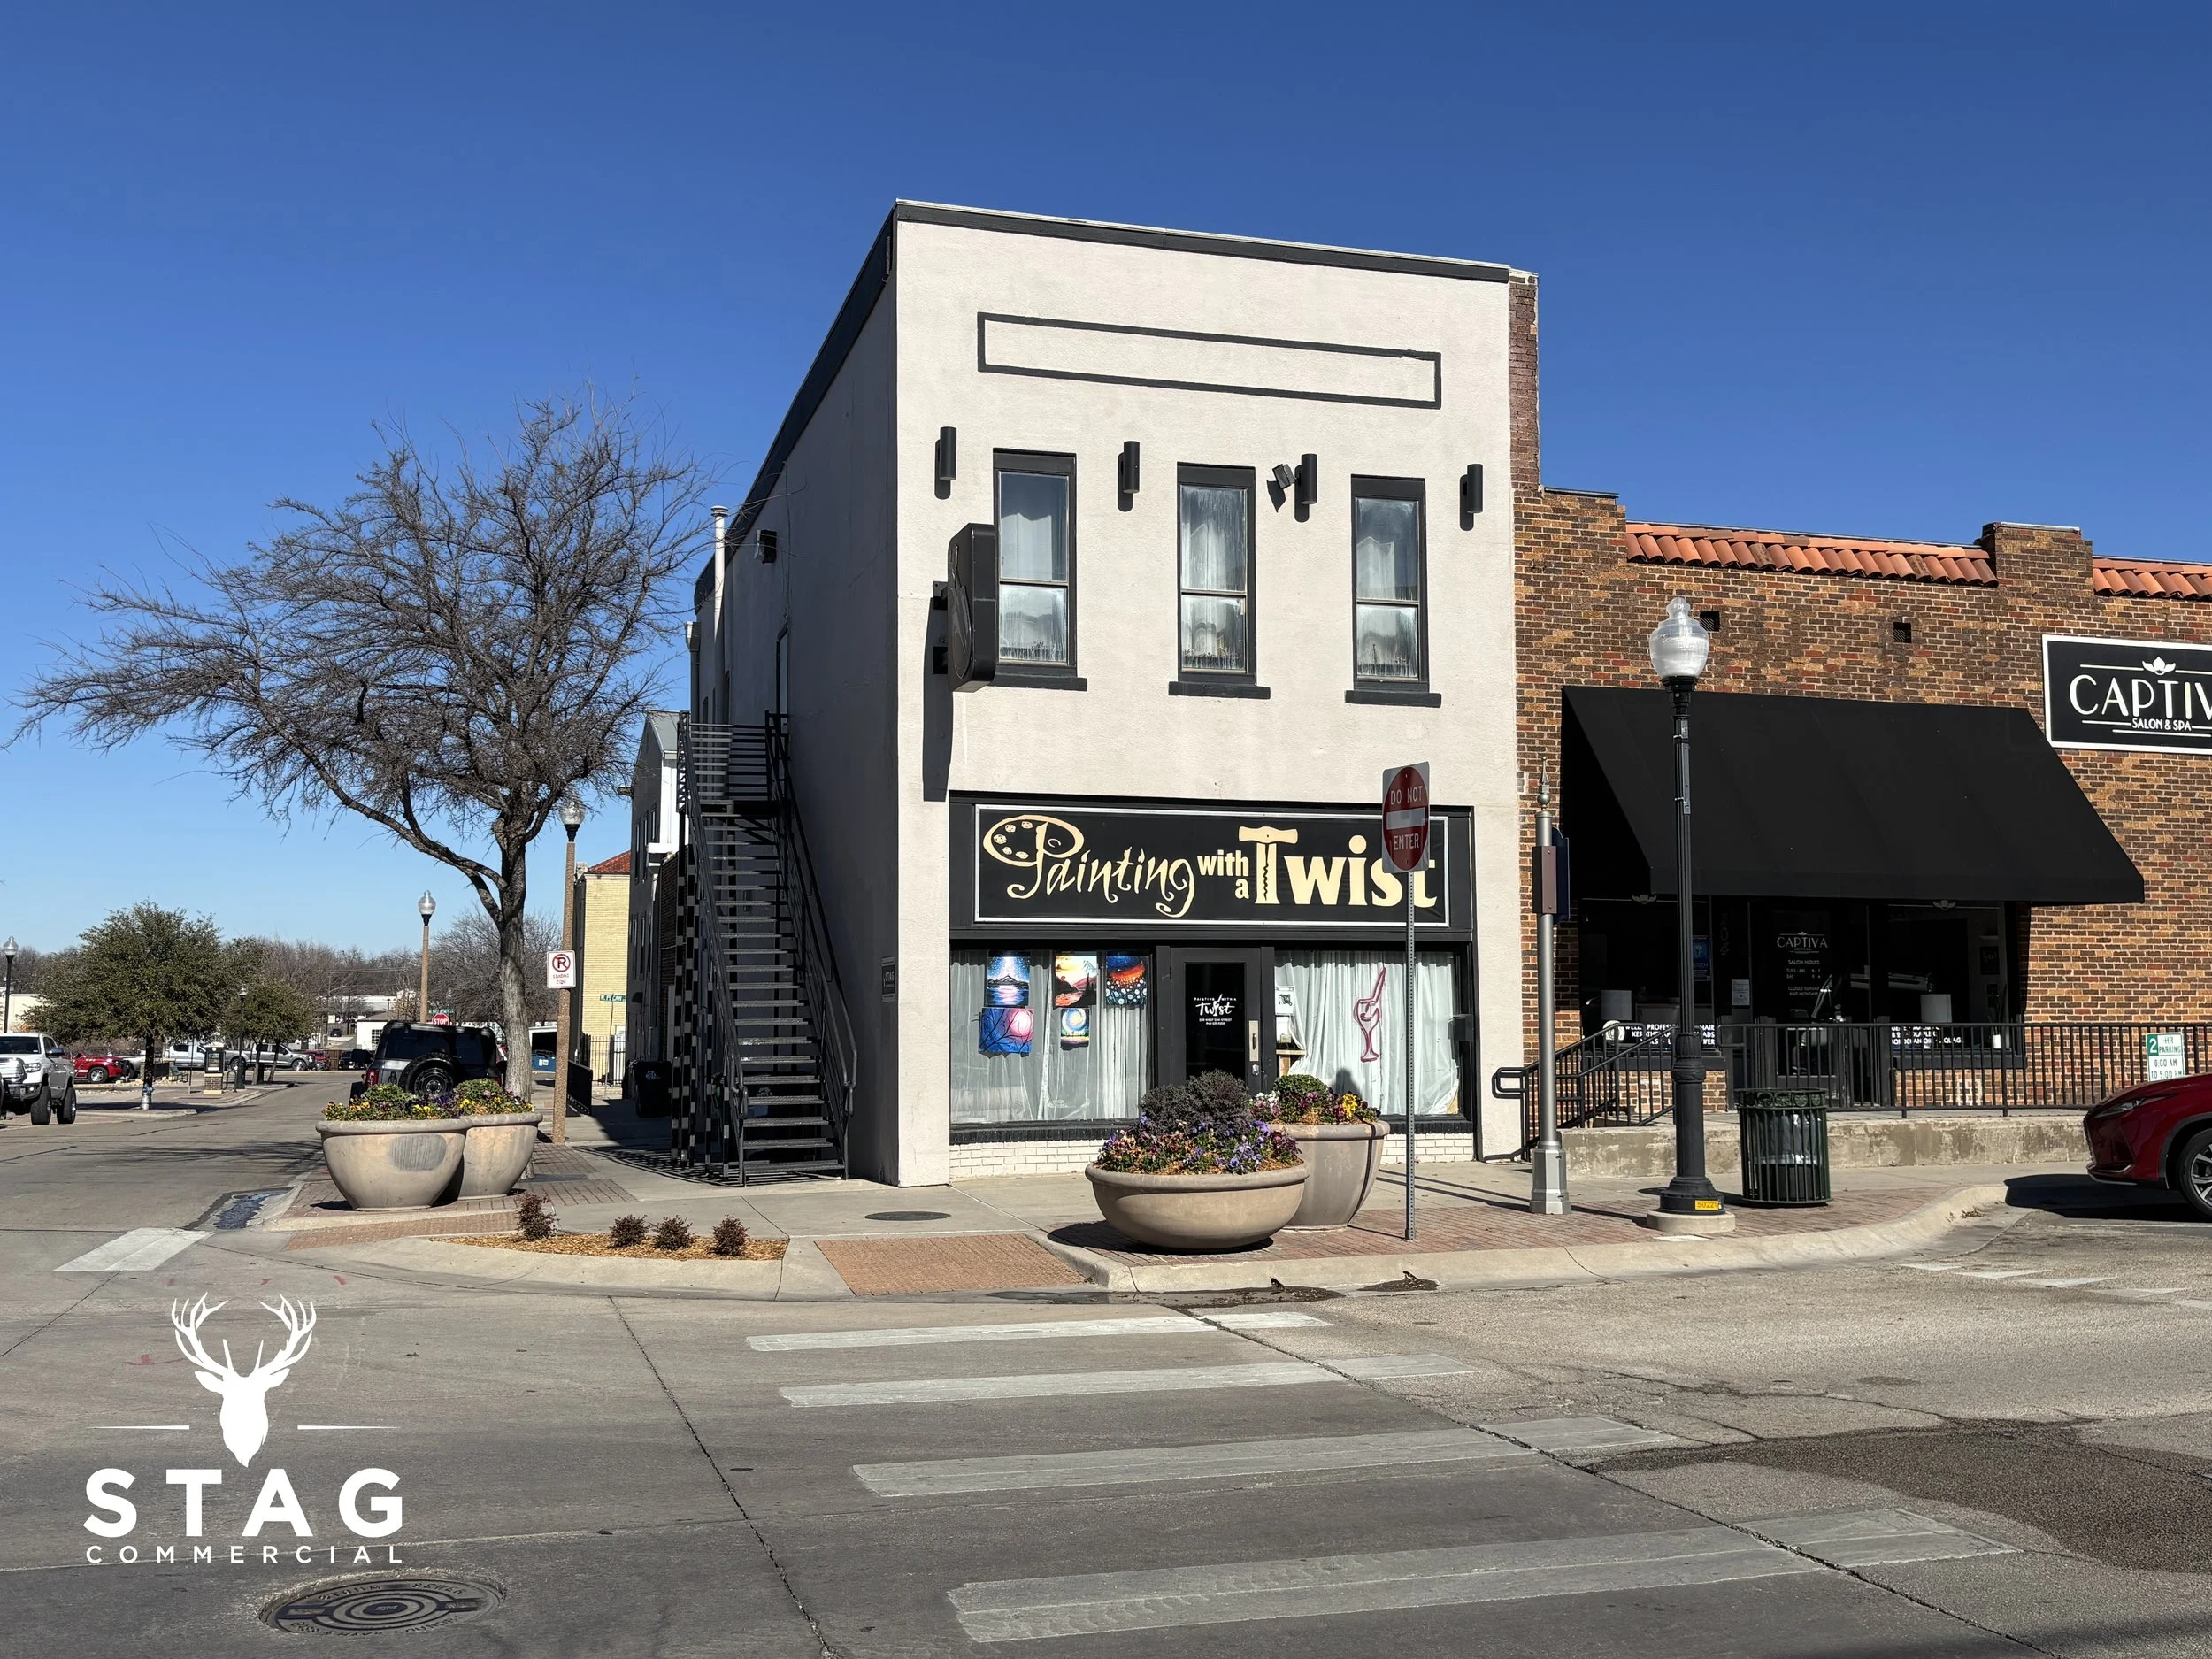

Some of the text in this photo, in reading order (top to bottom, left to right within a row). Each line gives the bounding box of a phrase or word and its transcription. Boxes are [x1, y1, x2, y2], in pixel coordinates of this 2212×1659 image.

[2131, 718, 2192, 732] SALON & SPA
[1390, 785, 1424, 806] DO NOT
[1394, 833, 1420, 850] ENTER
[982, 814, 1195, 918] Painting
[1196, 849, 1250, 877] with
[1234, 879, 1250, 900] a
[1777, 937, 1828, 948] CAPTIVA
[1195, 1000, 1235, 1017] Twist
[2149, 1038, 2158, 1053] 2
[2159, 1045, 2181, 1054] PARKING
